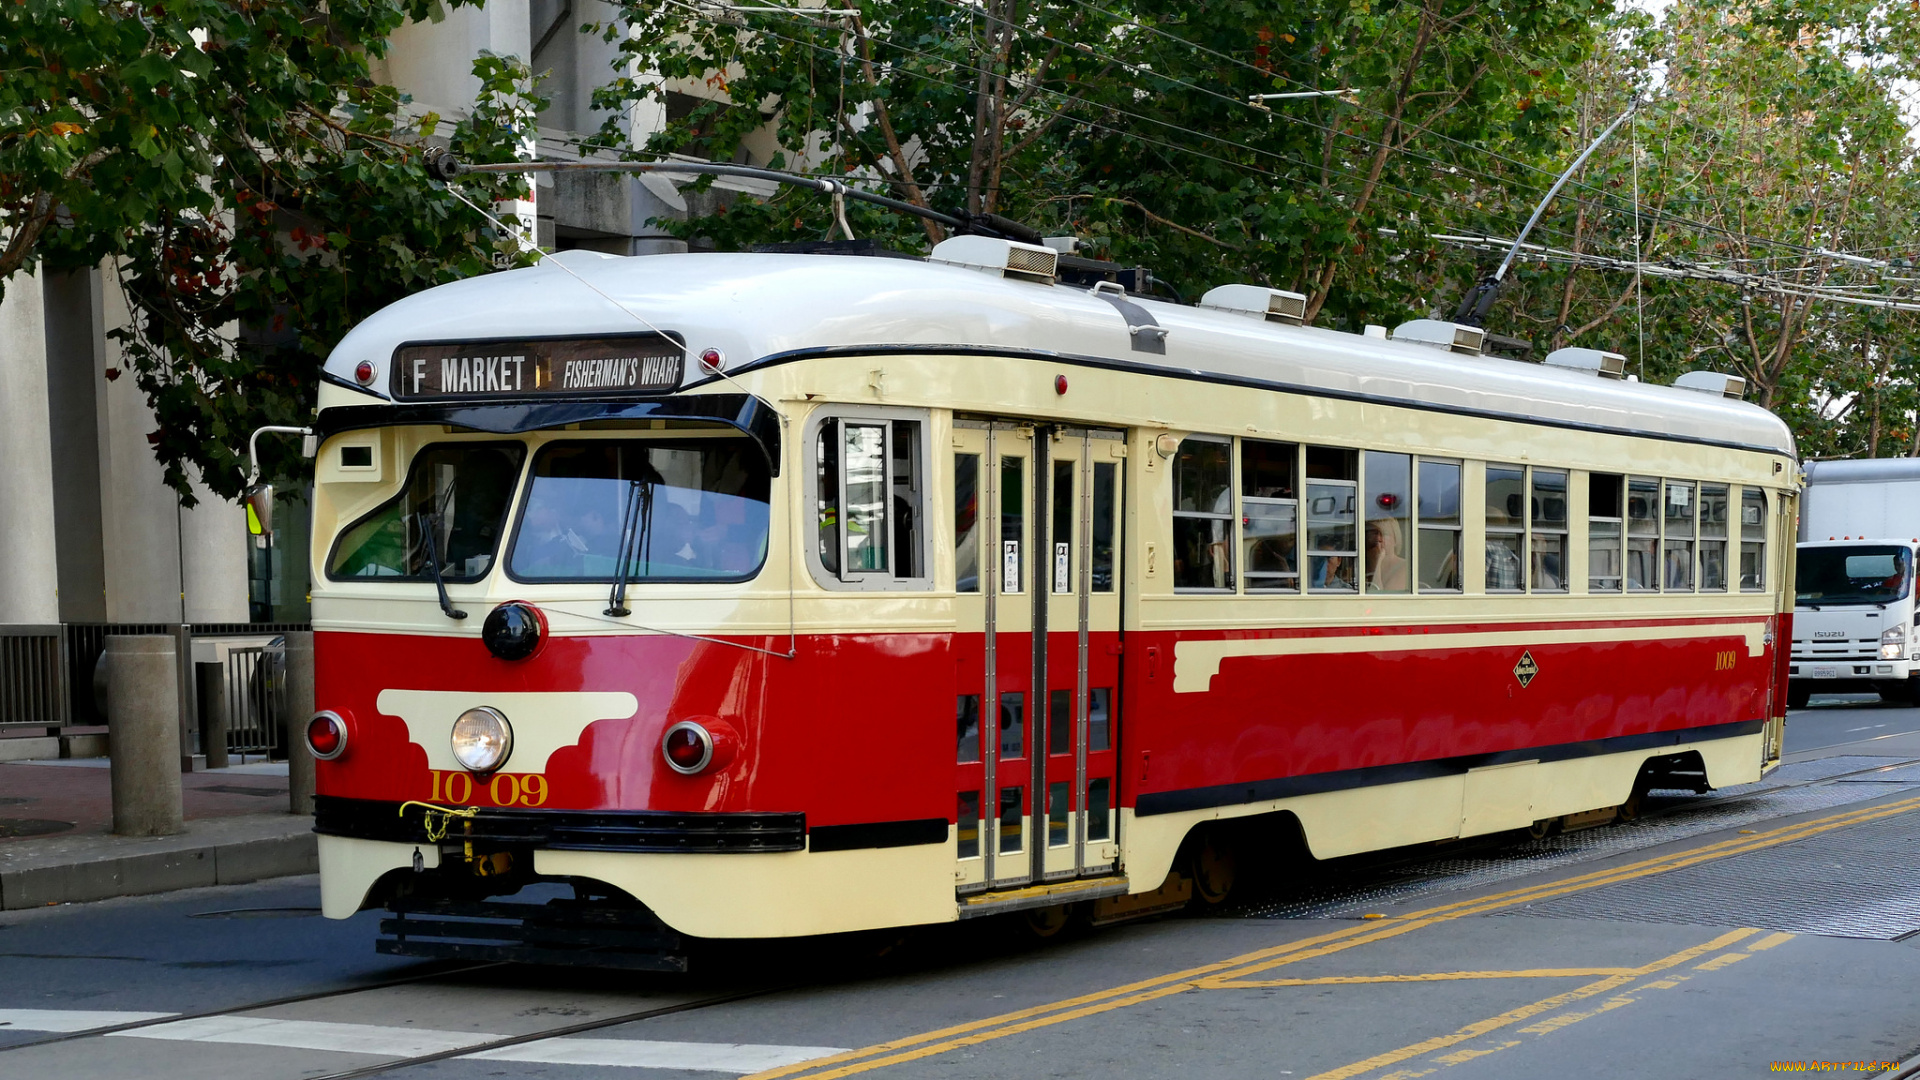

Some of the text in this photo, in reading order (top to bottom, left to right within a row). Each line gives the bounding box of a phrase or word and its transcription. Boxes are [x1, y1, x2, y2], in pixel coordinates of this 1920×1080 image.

[413, 355, 681, 394] F MARKET FISHERMAN'S WHARF
[1715, 650, 1736, 671] 1009
